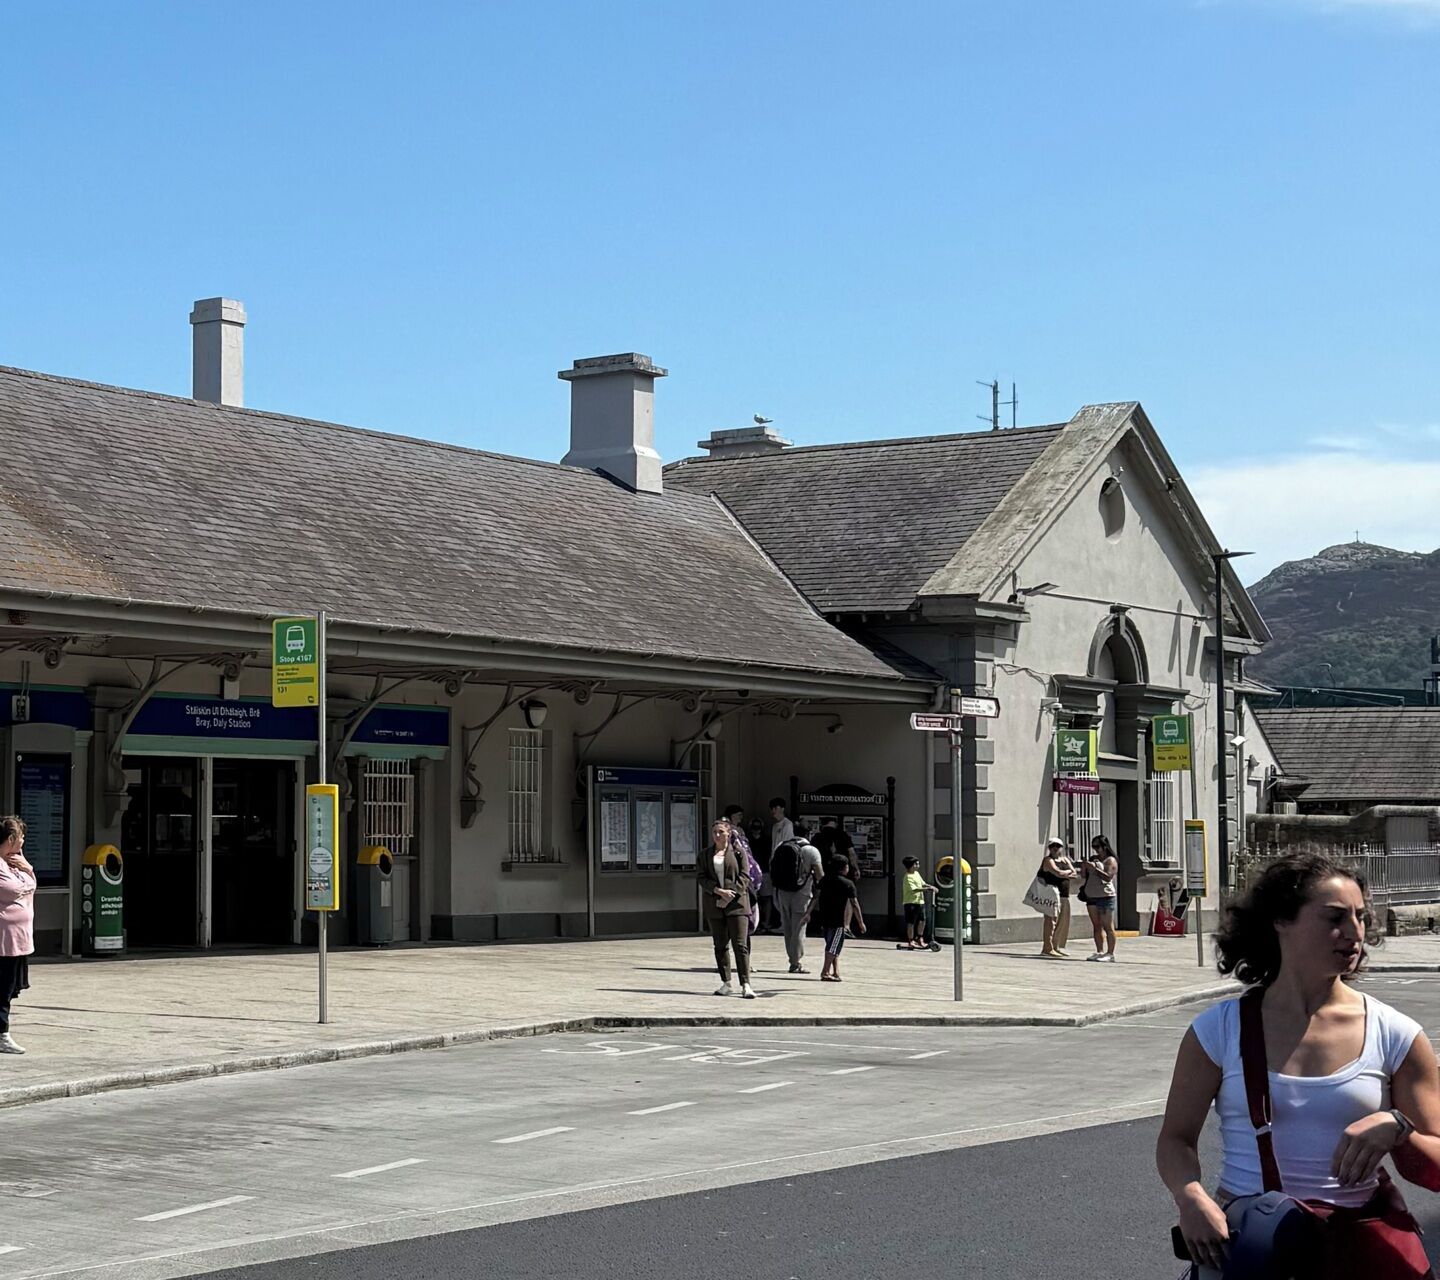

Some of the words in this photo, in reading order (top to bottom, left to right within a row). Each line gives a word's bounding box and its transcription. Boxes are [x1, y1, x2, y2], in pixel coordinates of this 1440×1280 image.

[195, 716, 212, 728] Bray,
[213, 717, 228, 729] Daly
[228, 718, 251, 728] Station
[810, 794, 834, 802] VISITOR
[834, 795, 876, 803] INFORMATION
[541, 1040, 810, 1065] BUS
